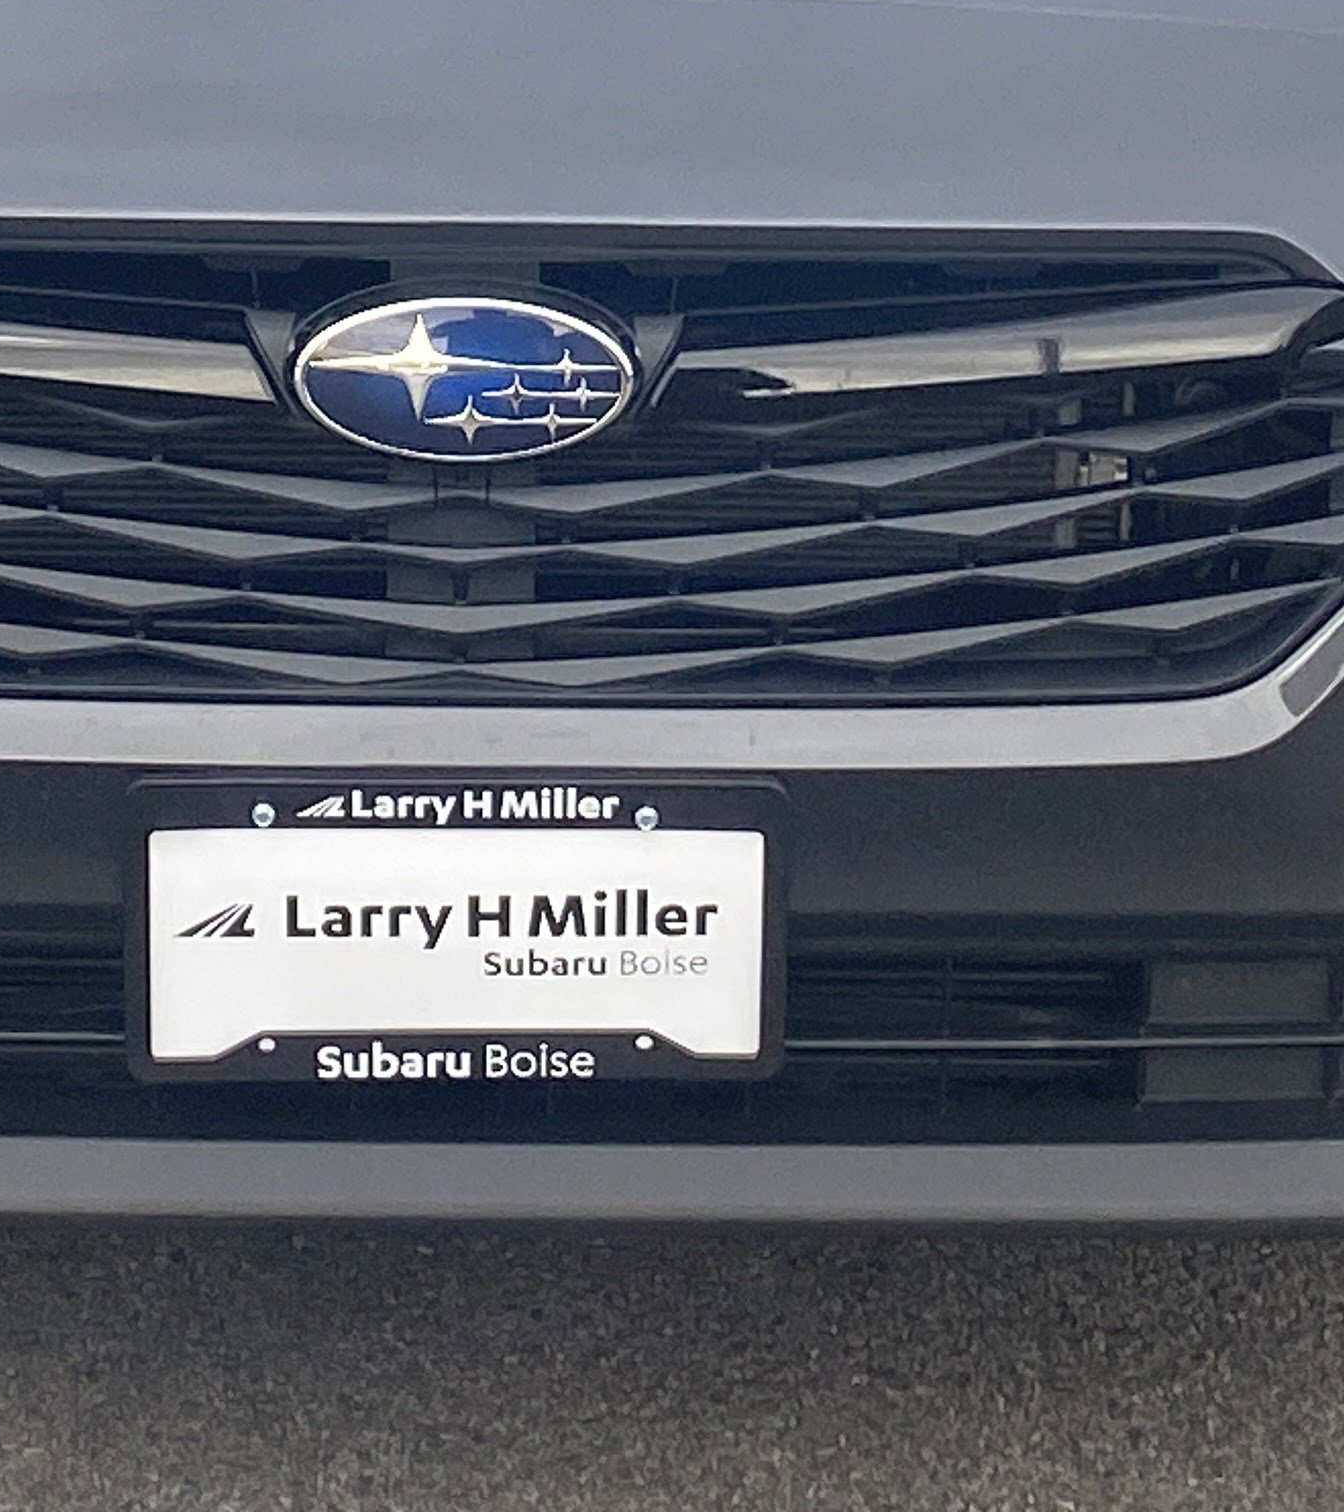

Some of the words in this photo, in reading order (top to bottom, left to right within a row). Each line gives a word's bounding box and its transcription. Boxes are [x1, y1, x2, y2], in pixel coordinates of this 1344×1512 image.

[351, 790, 455, 825] Larry
[462, 790, 492, 819] H
[500, 788, 620, 820] Miller
[286, 894, 453, 950] Larry
[468, 894, 512, 938] H
[527, 889, 718, 938] Miller
[484, 948, 608, 977] Subaru
[619, 950, 708, 976] Boise
[316, 1041, 472, 1080] Subaru
[484, 1042, 596, 1079] Boise
